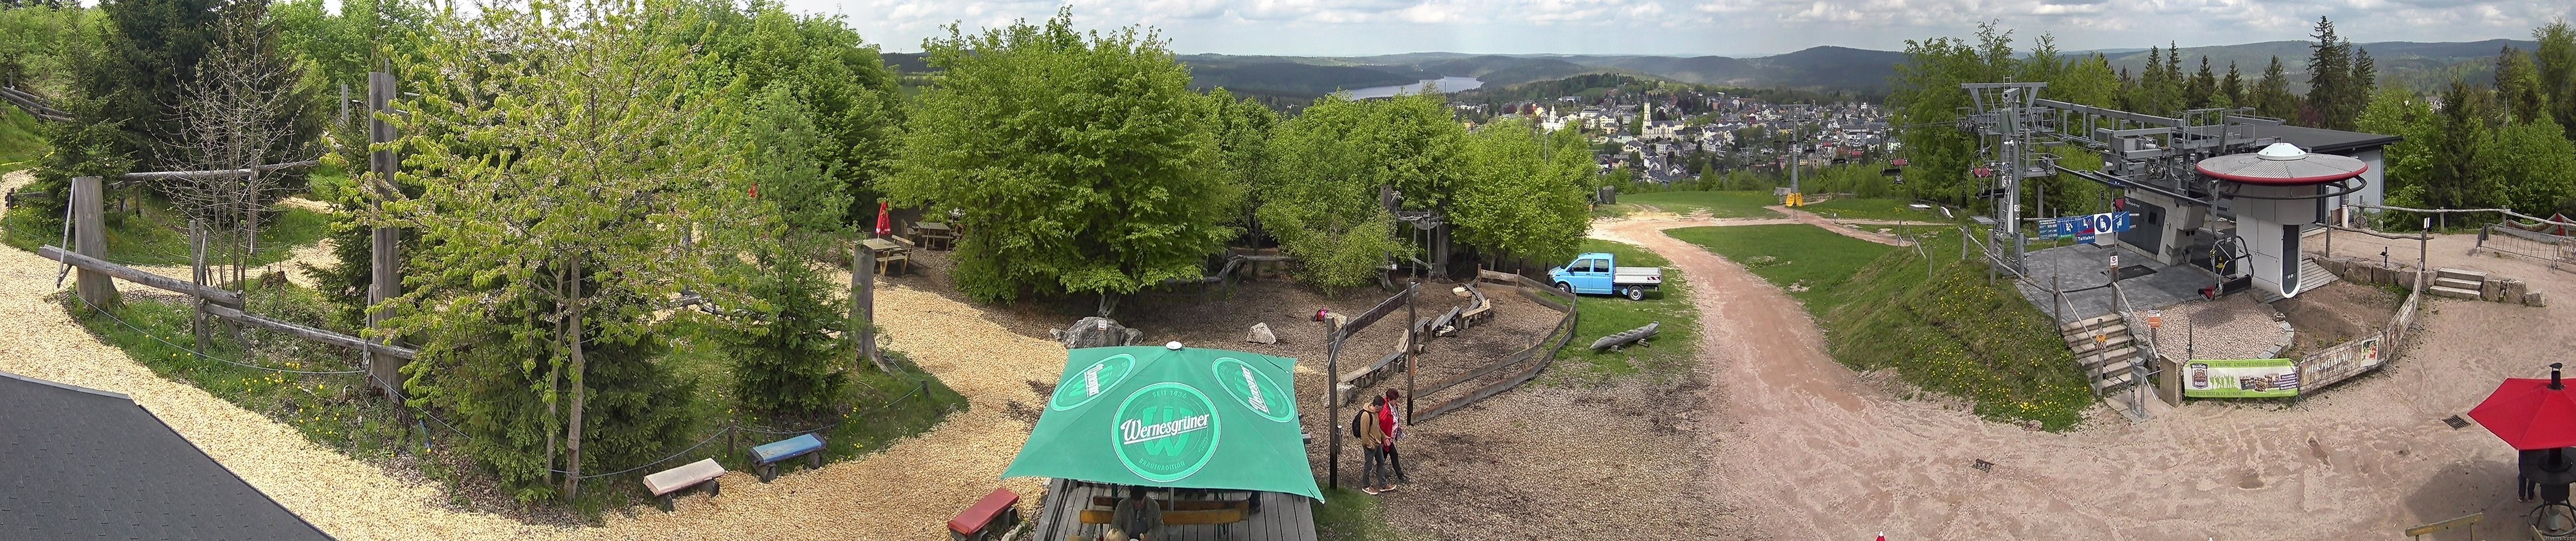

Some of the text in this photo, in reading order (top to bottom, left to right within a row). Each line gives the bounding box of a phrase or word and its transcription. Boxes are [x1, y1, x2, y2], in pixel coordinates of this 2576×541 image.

[1152, 390, 1187, 399] SEIT 1436
[1120, 413, 1210, 442] Wernesgrüner
[1138, 457, 1185, 471] BRAUTRADITION
